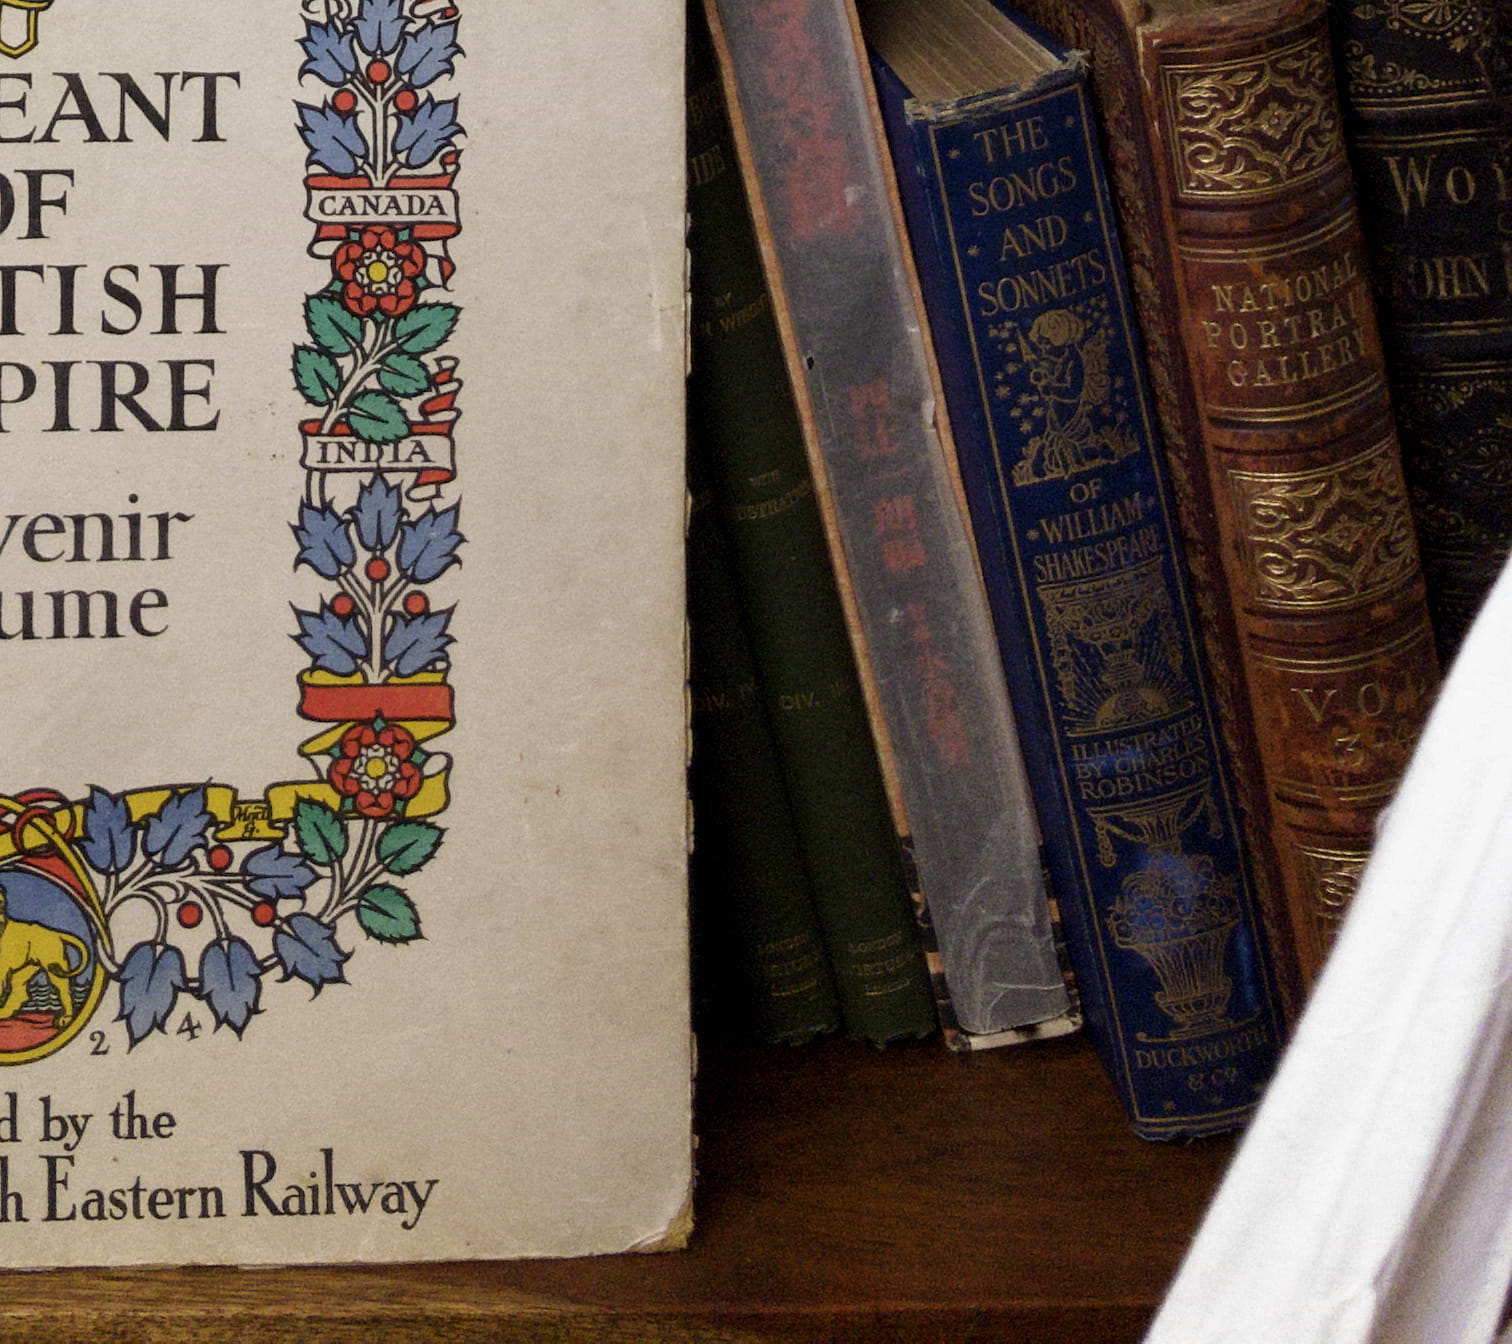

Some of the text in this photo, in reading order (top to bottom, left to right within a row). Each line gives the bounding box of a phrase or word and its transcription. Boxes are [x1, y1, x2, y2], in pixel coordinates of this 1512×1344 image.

[973, 116, 1050, 163] THE
[318, 194, 449, 217] CANADA
[968, 155, 1078, 217] SONGS
[999, 214, 1068, 262] AND
[977, 248, 1107, 317] SONNETS
[1211, 251, 1358, 313] NATIONAL
[1226, 325, 1367, 388] GALLERY
[317, 439, 434, 465] INDIA
[1069, 478, 1104, 504] OF
[1039, 491, 1145, 545] WILLIAM
[1033, 525, 1165, 584] SHAKESPEARE
[1071, 714, 1204, 761] ILLUSTRATED
[1076, 738, 1206, 781] BY CHARLES
[1079, 759, 1211, 801] ROBINSON
[1136, 1024, 1269, 1071] DUCKWORTH
[38, 1092, 94, 1152] by
[109, 1089, 177, 1142] the
[40, 1153, 226, 1222] Eastern
[240, 1148, 440, 1231] Railway
